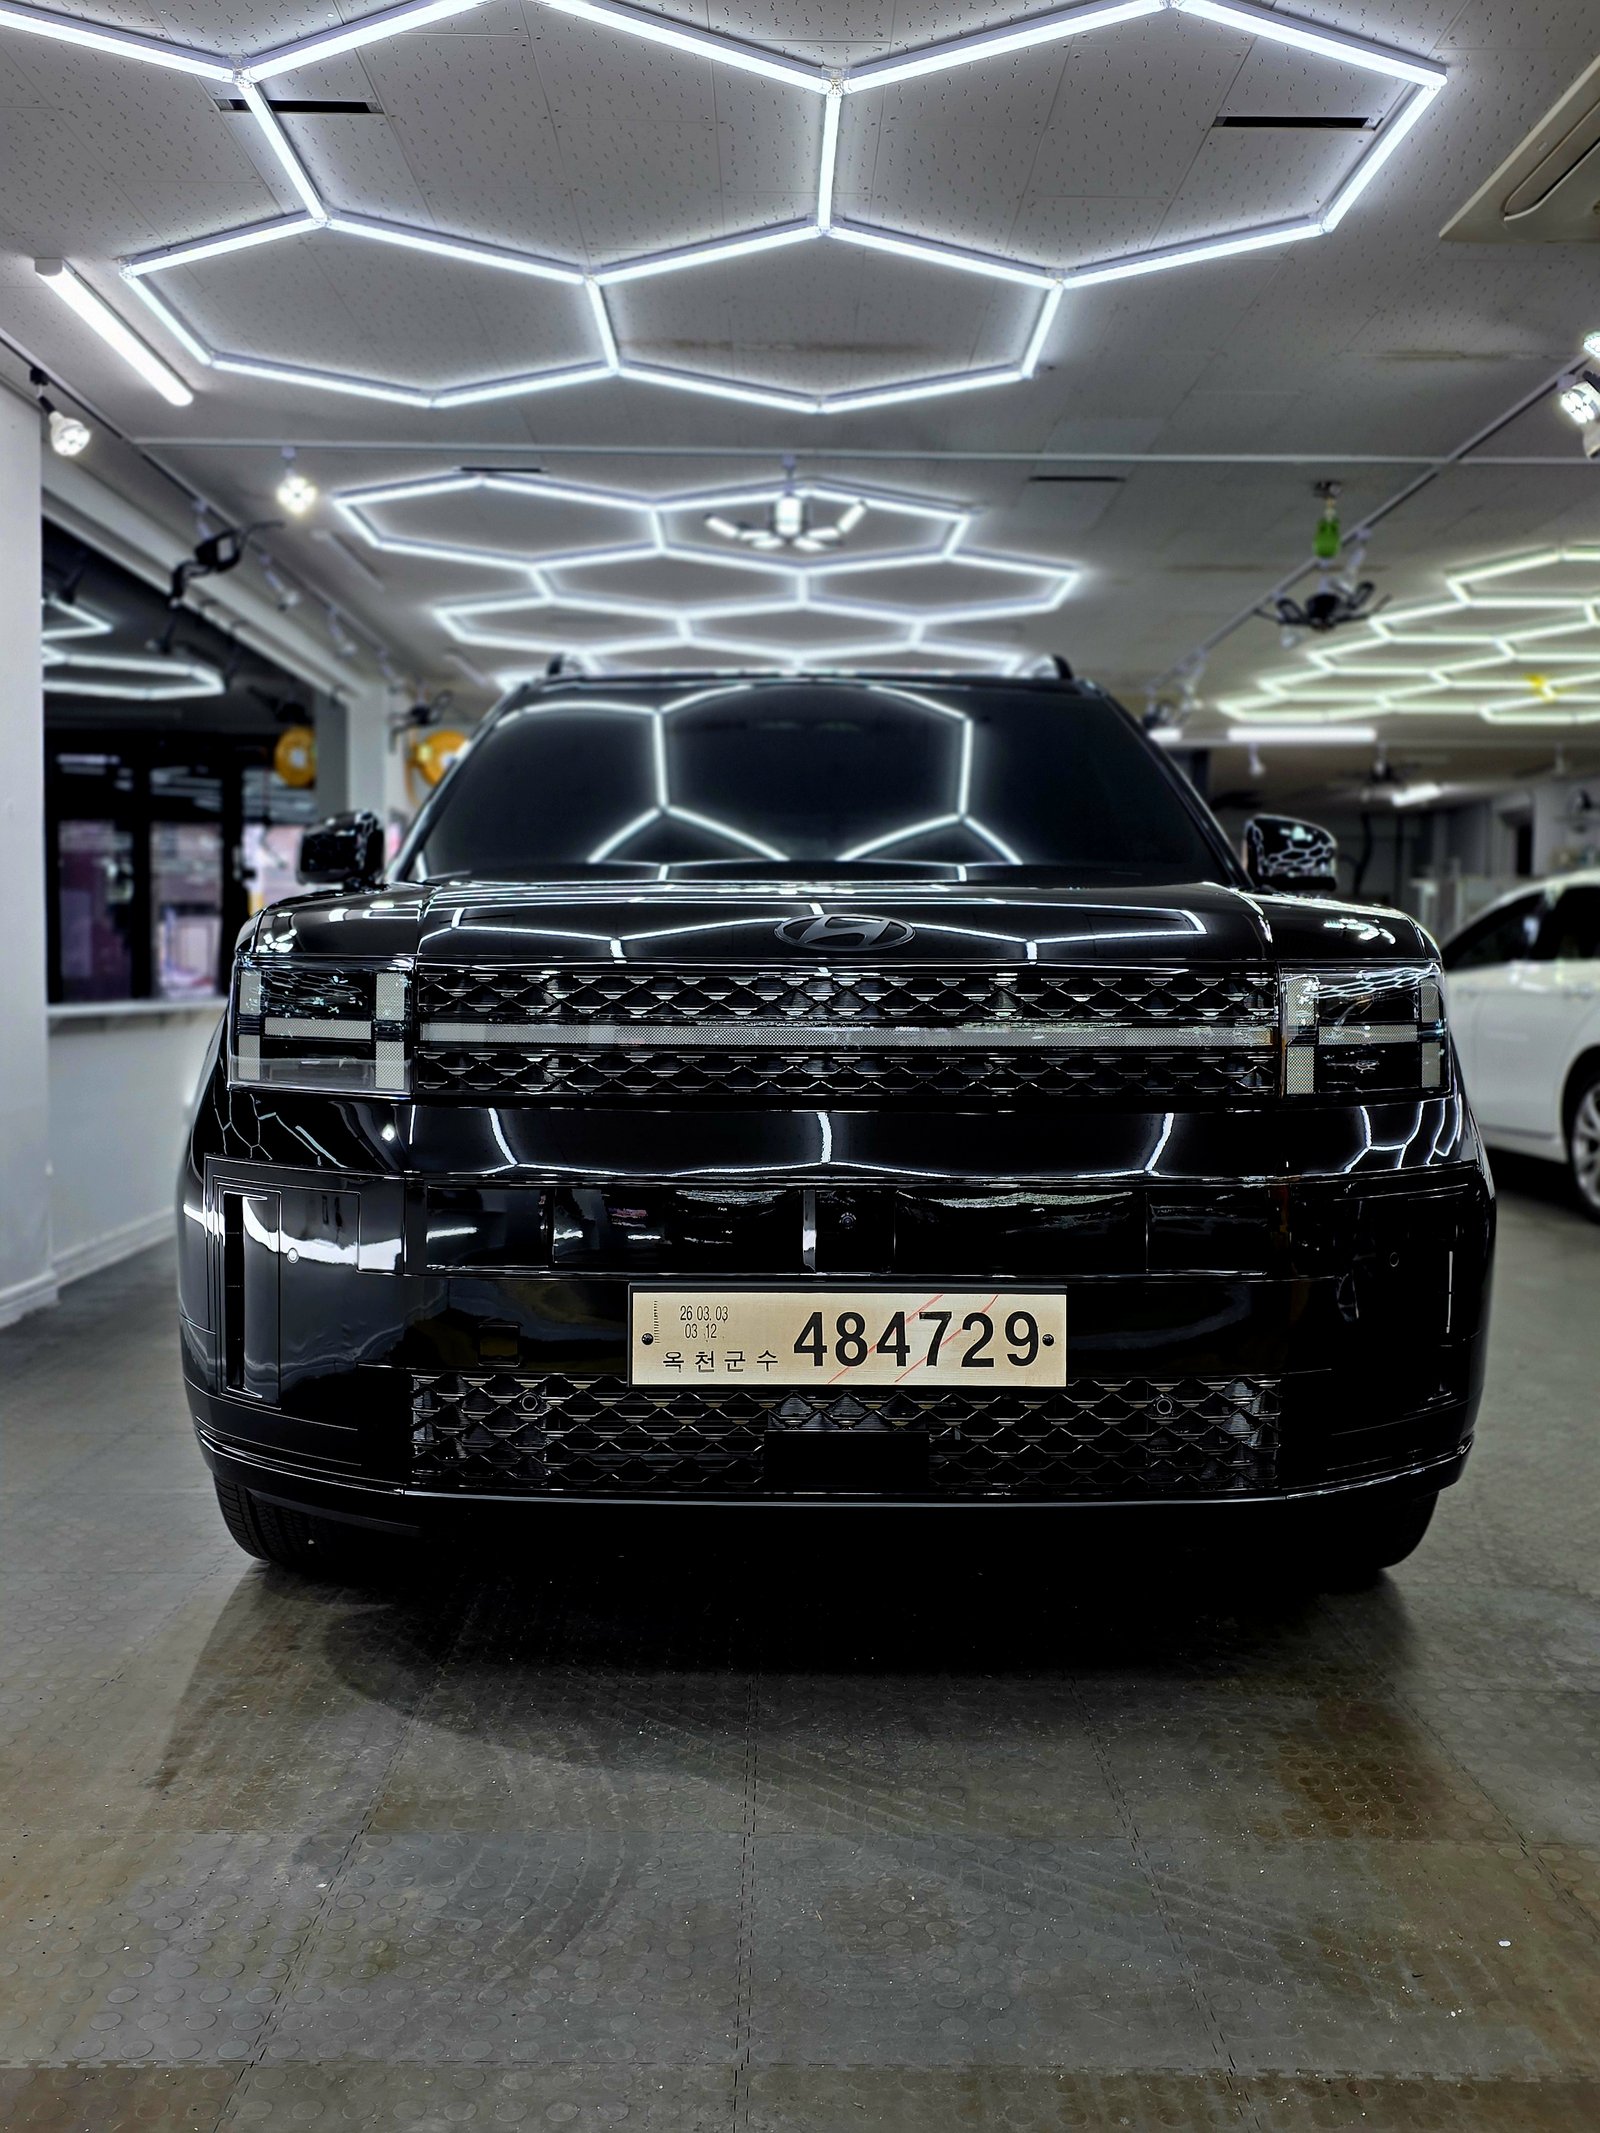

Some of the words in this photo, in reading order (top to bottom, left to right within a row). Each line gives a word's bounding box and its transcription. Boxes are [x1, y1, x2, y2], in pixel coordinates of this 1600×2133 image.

[679, 1305, 693, 1321] 26
[715, 1305, 729, 1321] 03
[684, 1323, 698, 1339] 03
[793, 1311, 1039, 1367] 484729
